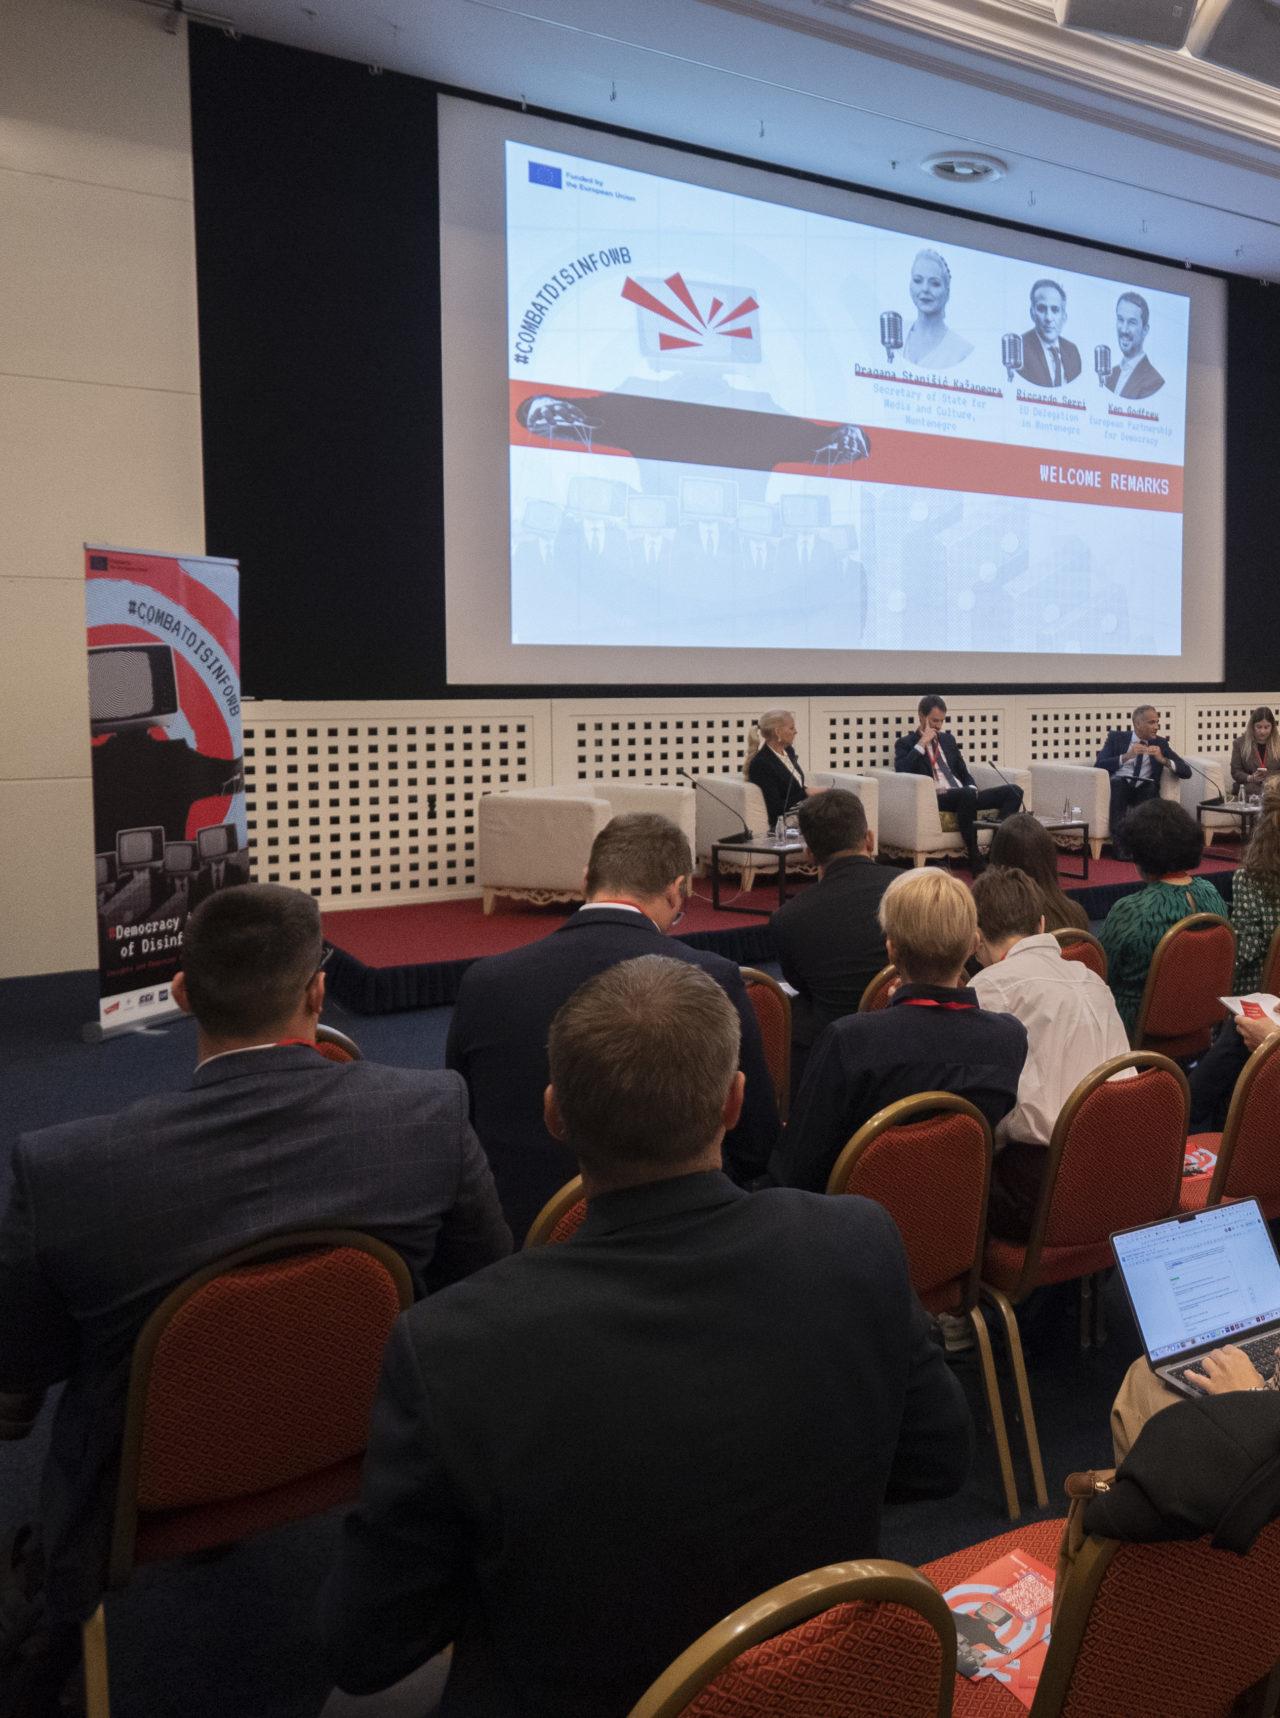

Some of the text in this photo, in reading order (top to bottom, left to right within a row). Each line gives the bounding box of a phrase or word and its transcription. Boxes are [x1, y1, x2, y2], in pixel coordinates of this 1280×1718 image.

[514, 246, 632, 365] #COMBATDISINFOWB
[854, 362, 897, 380] Dragana
[873, 382, 987, 409] Secretary of State for
[916, 402, 933, 415] and
[1016, 388, 1058, 404] Riccardo
[1108, 402, 1159, 420] Ken Godfrey
[1039, 463, 1169, 495] WELCOME REMARKS
[128, 599, 240, 718] #COMBATDISINFOWB
[120, 931, 184, 958] of Disinf
